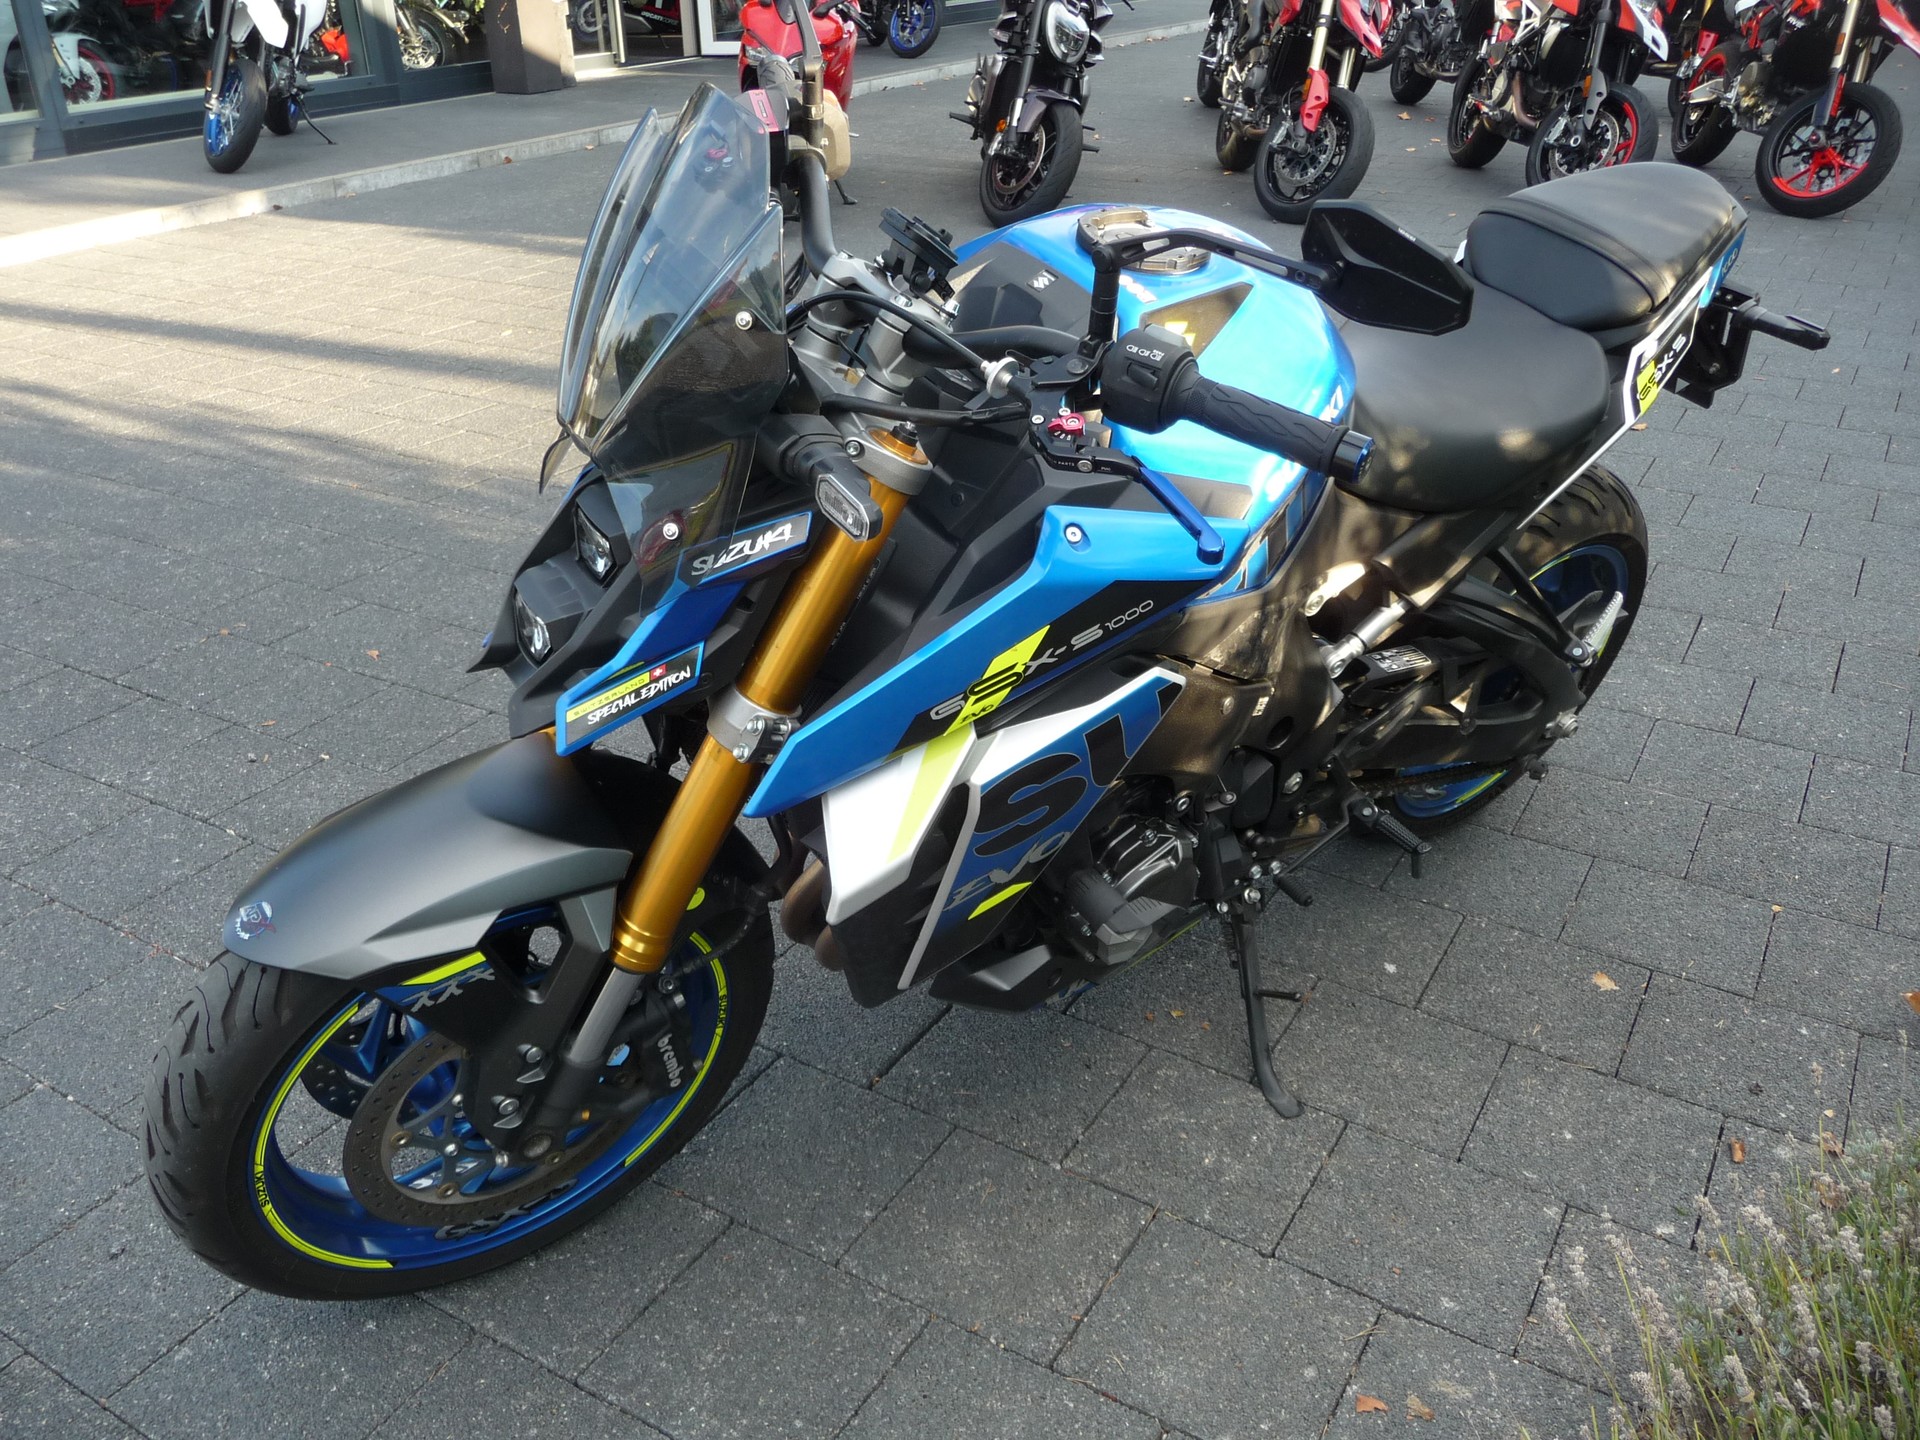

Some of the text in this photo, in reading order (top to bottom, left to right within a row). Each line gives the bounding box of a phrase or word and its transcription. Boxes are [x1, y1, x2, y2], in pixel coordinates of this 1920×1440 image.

[641, 10, 664, 20] DUCATI
[1721, 247, 1740, 278] 1000
[1637, 333, 1687, 401] GSX-S
[691, 523, 795, 576] SUZUKI
[572, 678, 646, 717] SWITZERLAND
[587, 665, 691, 726] SPECIAL EDITION
[960, 704, 995, 723] EVO
[943, 831, 1072, 912] EVO
[717, 994, 727, 1029] SUZUKI
[657, 1033, 684, 1088] brembo
[254, 1170, 270, 1208] SUZUKI
